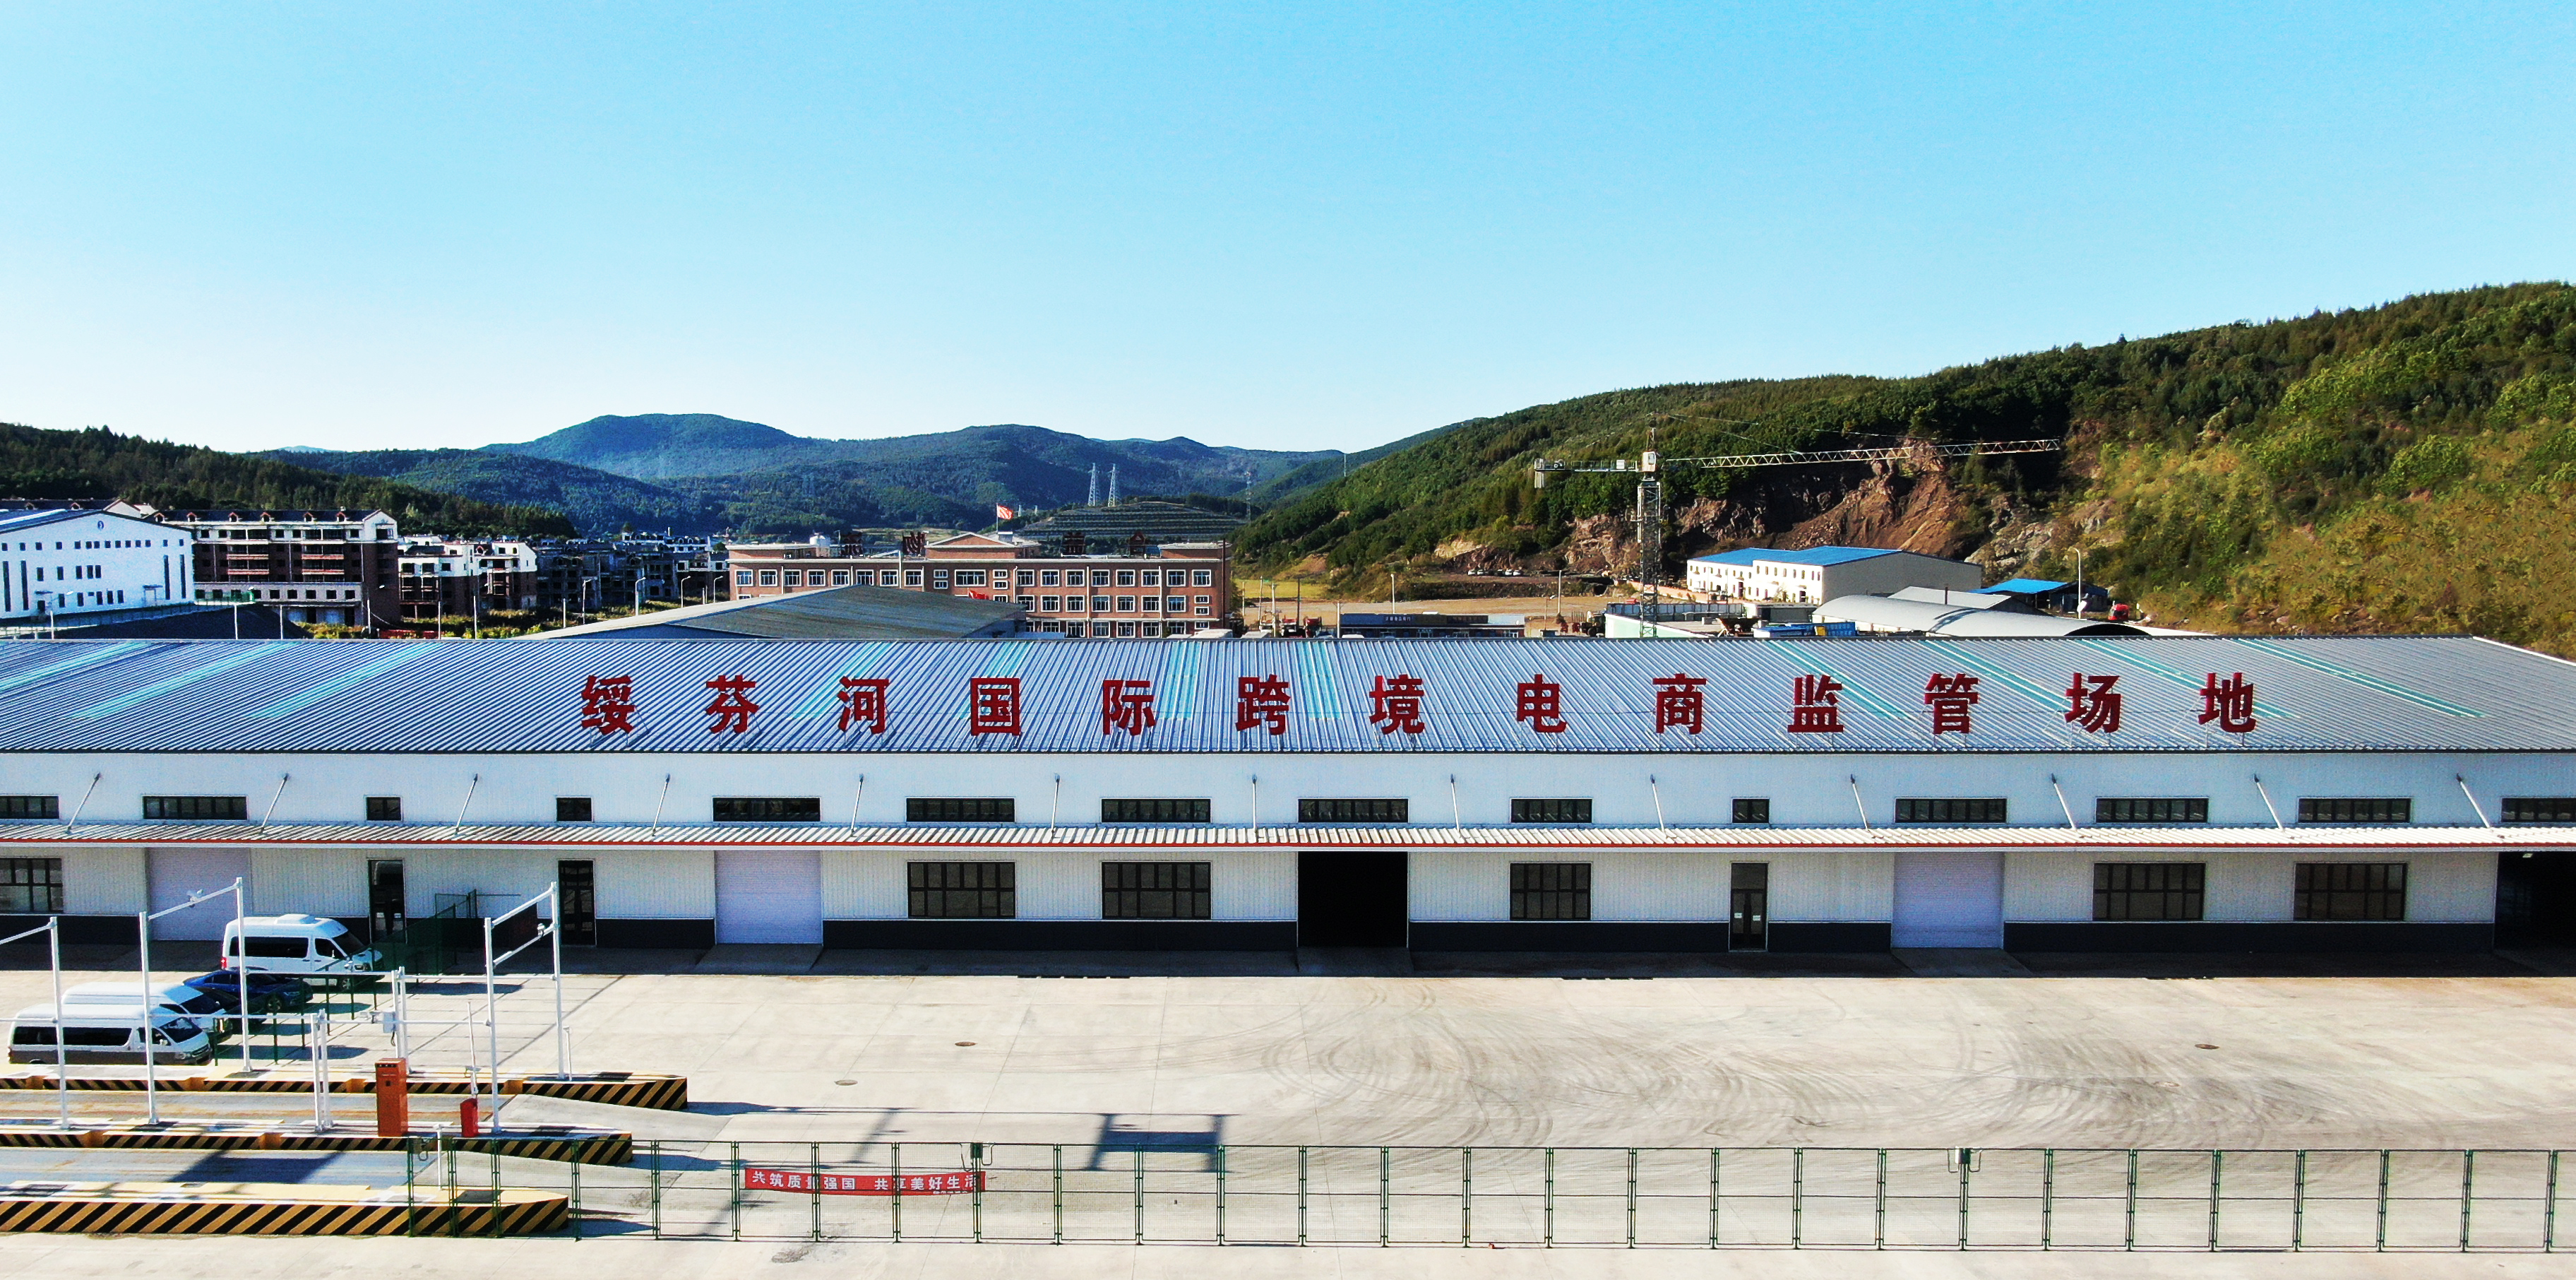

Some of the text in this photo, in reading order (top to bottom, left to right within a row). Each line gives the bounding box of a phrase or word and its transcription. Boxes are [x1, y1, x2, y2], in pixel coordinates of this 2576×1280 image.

[581, 671, 2253, 735] 绥芬河国际跨境电商监管场地
